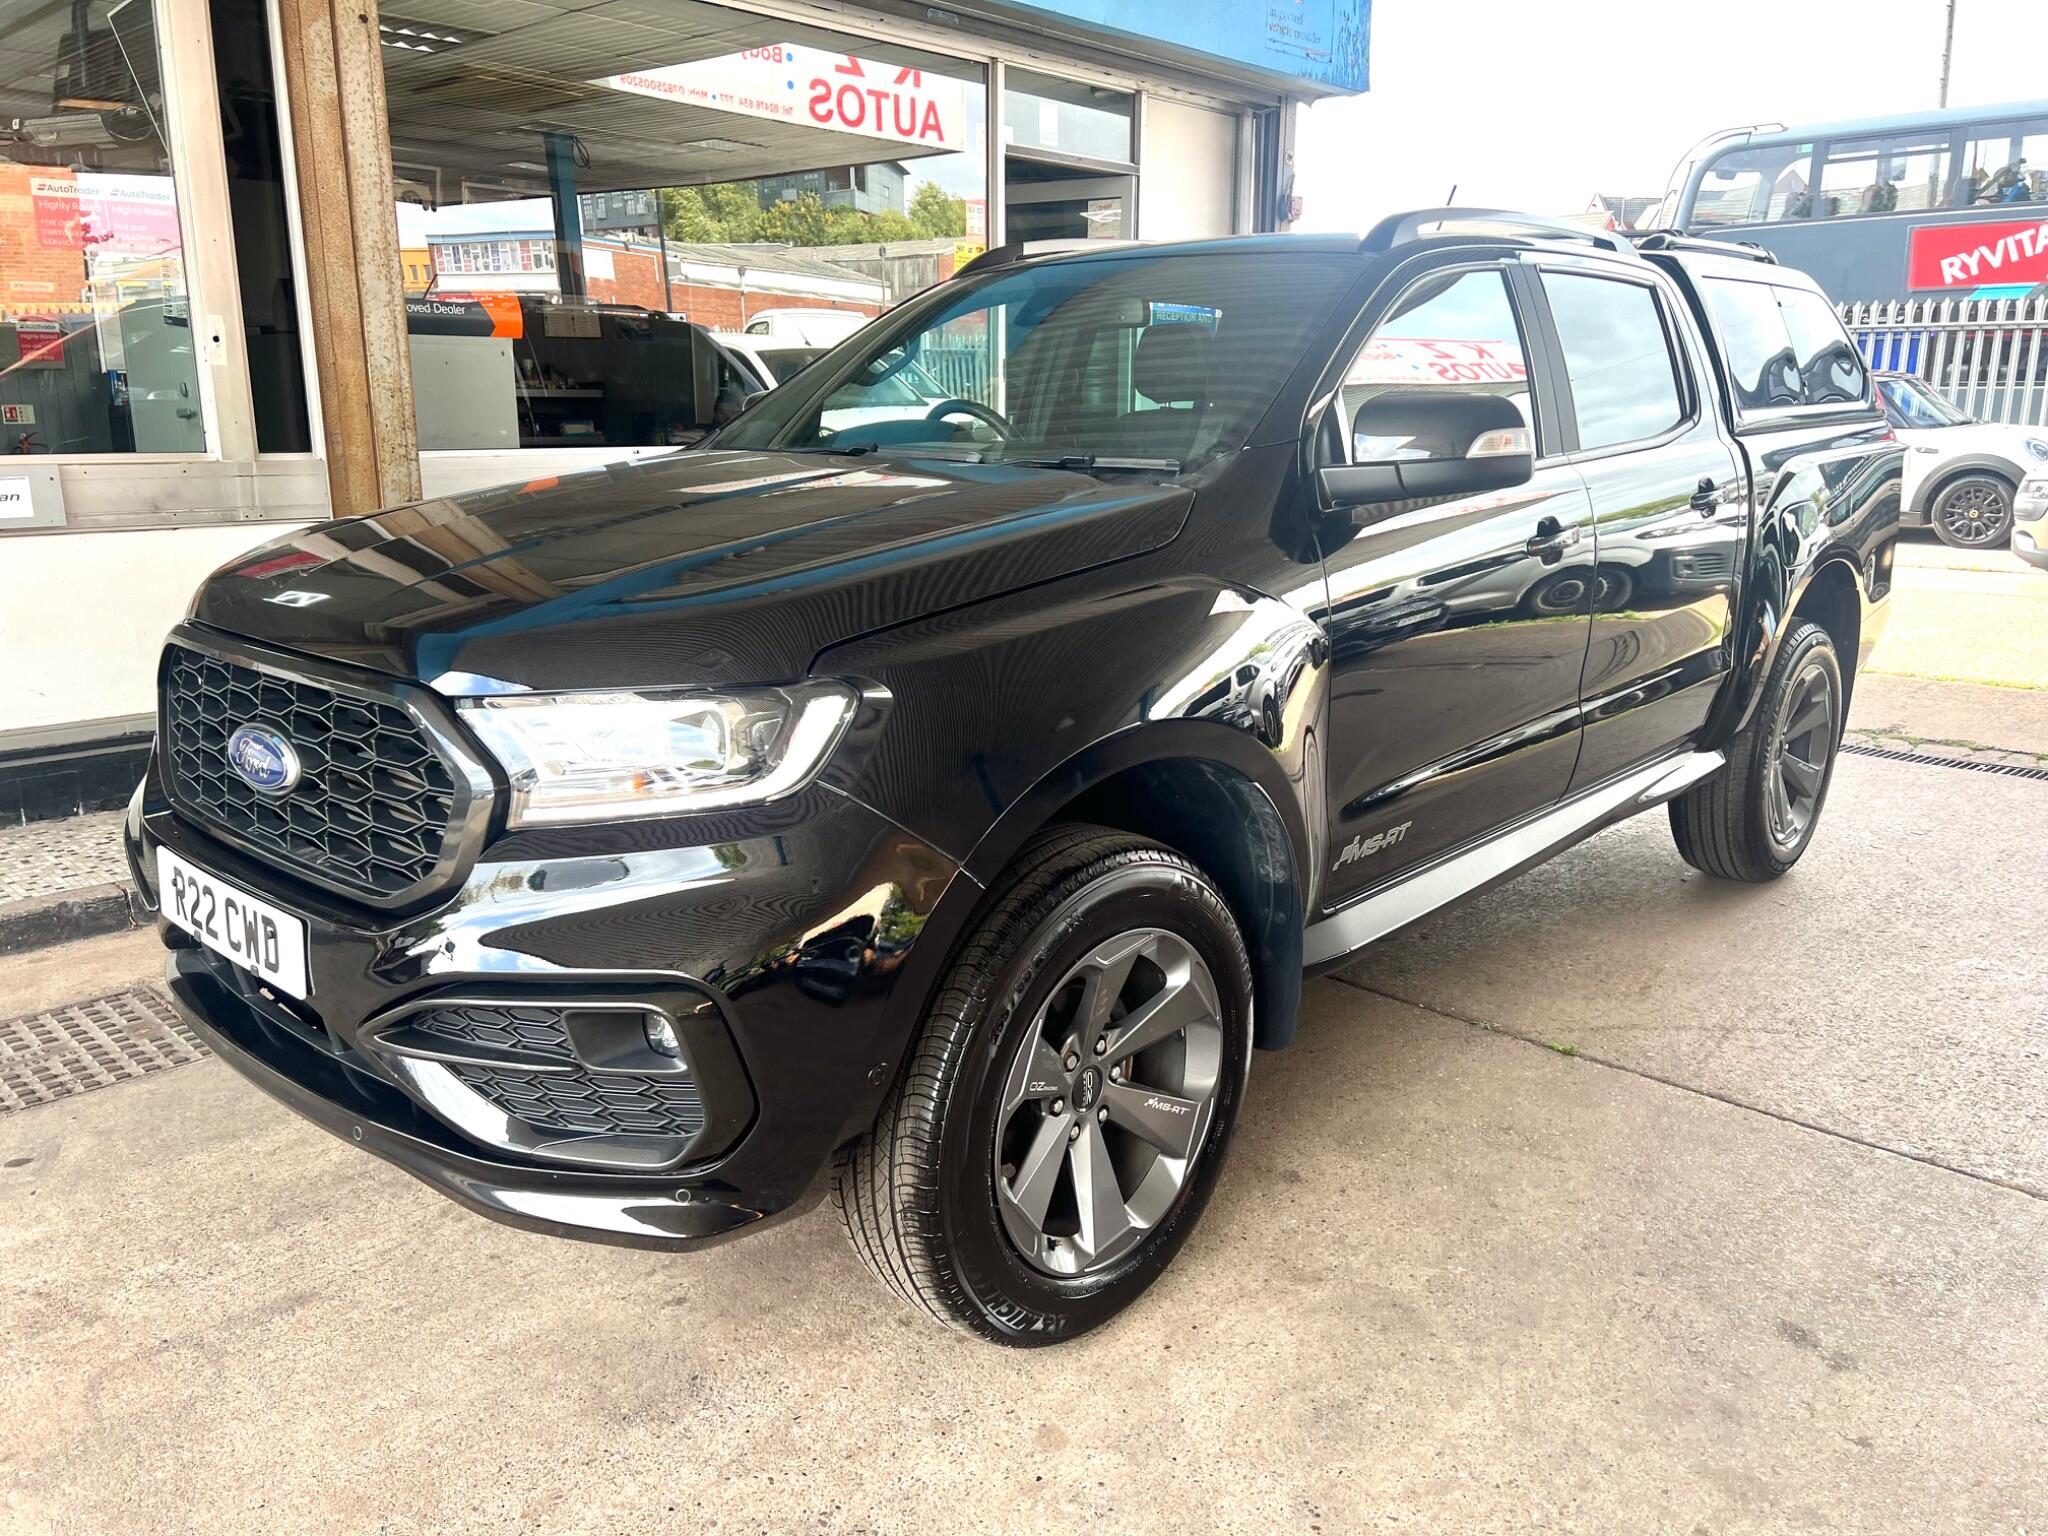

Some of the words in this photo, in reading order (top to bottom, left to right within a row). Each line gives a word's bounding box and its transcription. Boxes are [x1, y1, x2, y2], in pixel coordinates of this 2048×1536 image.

[433, 303, 466, 315] Dealer
[236, 737, 271, 779] Ford
[173, 865, 219, 941] R22
[224, 896, 280, 974] CWD
